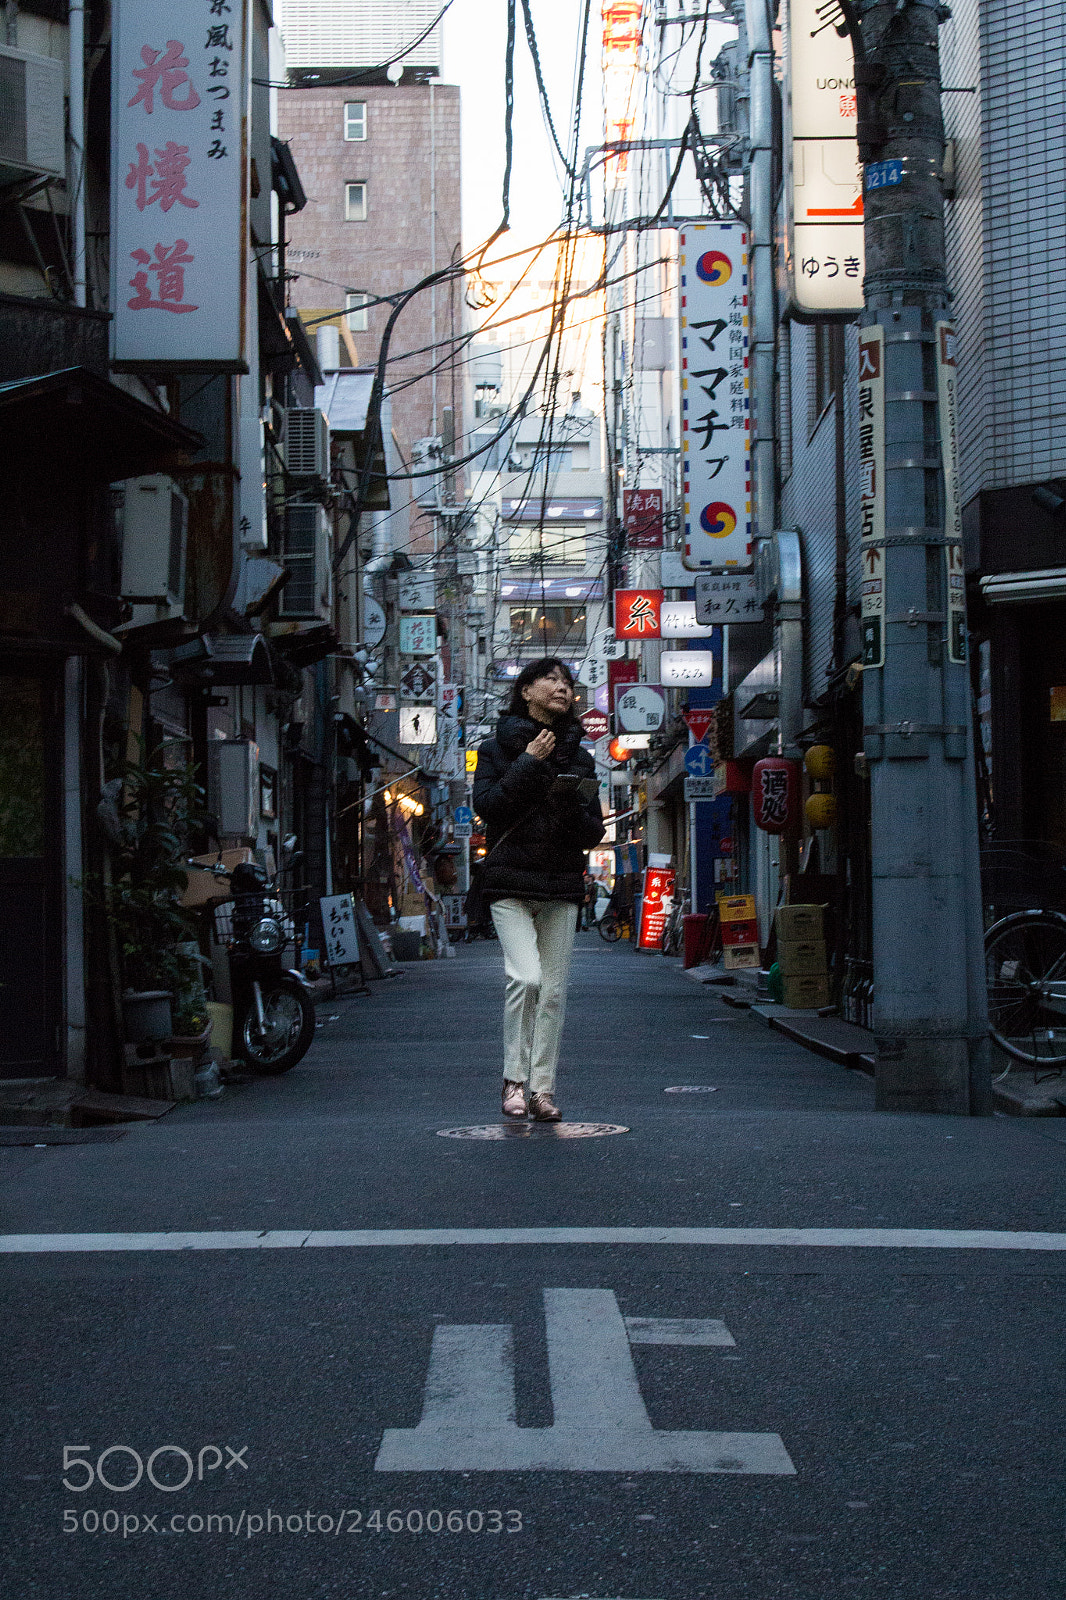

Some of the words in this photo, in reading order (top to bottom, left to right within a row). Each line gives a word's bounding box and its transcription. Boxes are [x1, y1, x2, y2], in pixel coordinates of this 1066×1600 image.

[125, 40, 201, 315] 花懐道
[800, 255, 861, 279] ゆうき
[728, 294, 745, 431] 本場韓国家庭料理
[689, 318, 730, 480] ママチプ
[626, 493, 660, 511] 焼肉
[624, 595, 658, 632] 糸
[704, 598, 761, 615] 和久井
[761, 769, 790, 824] 酒処
